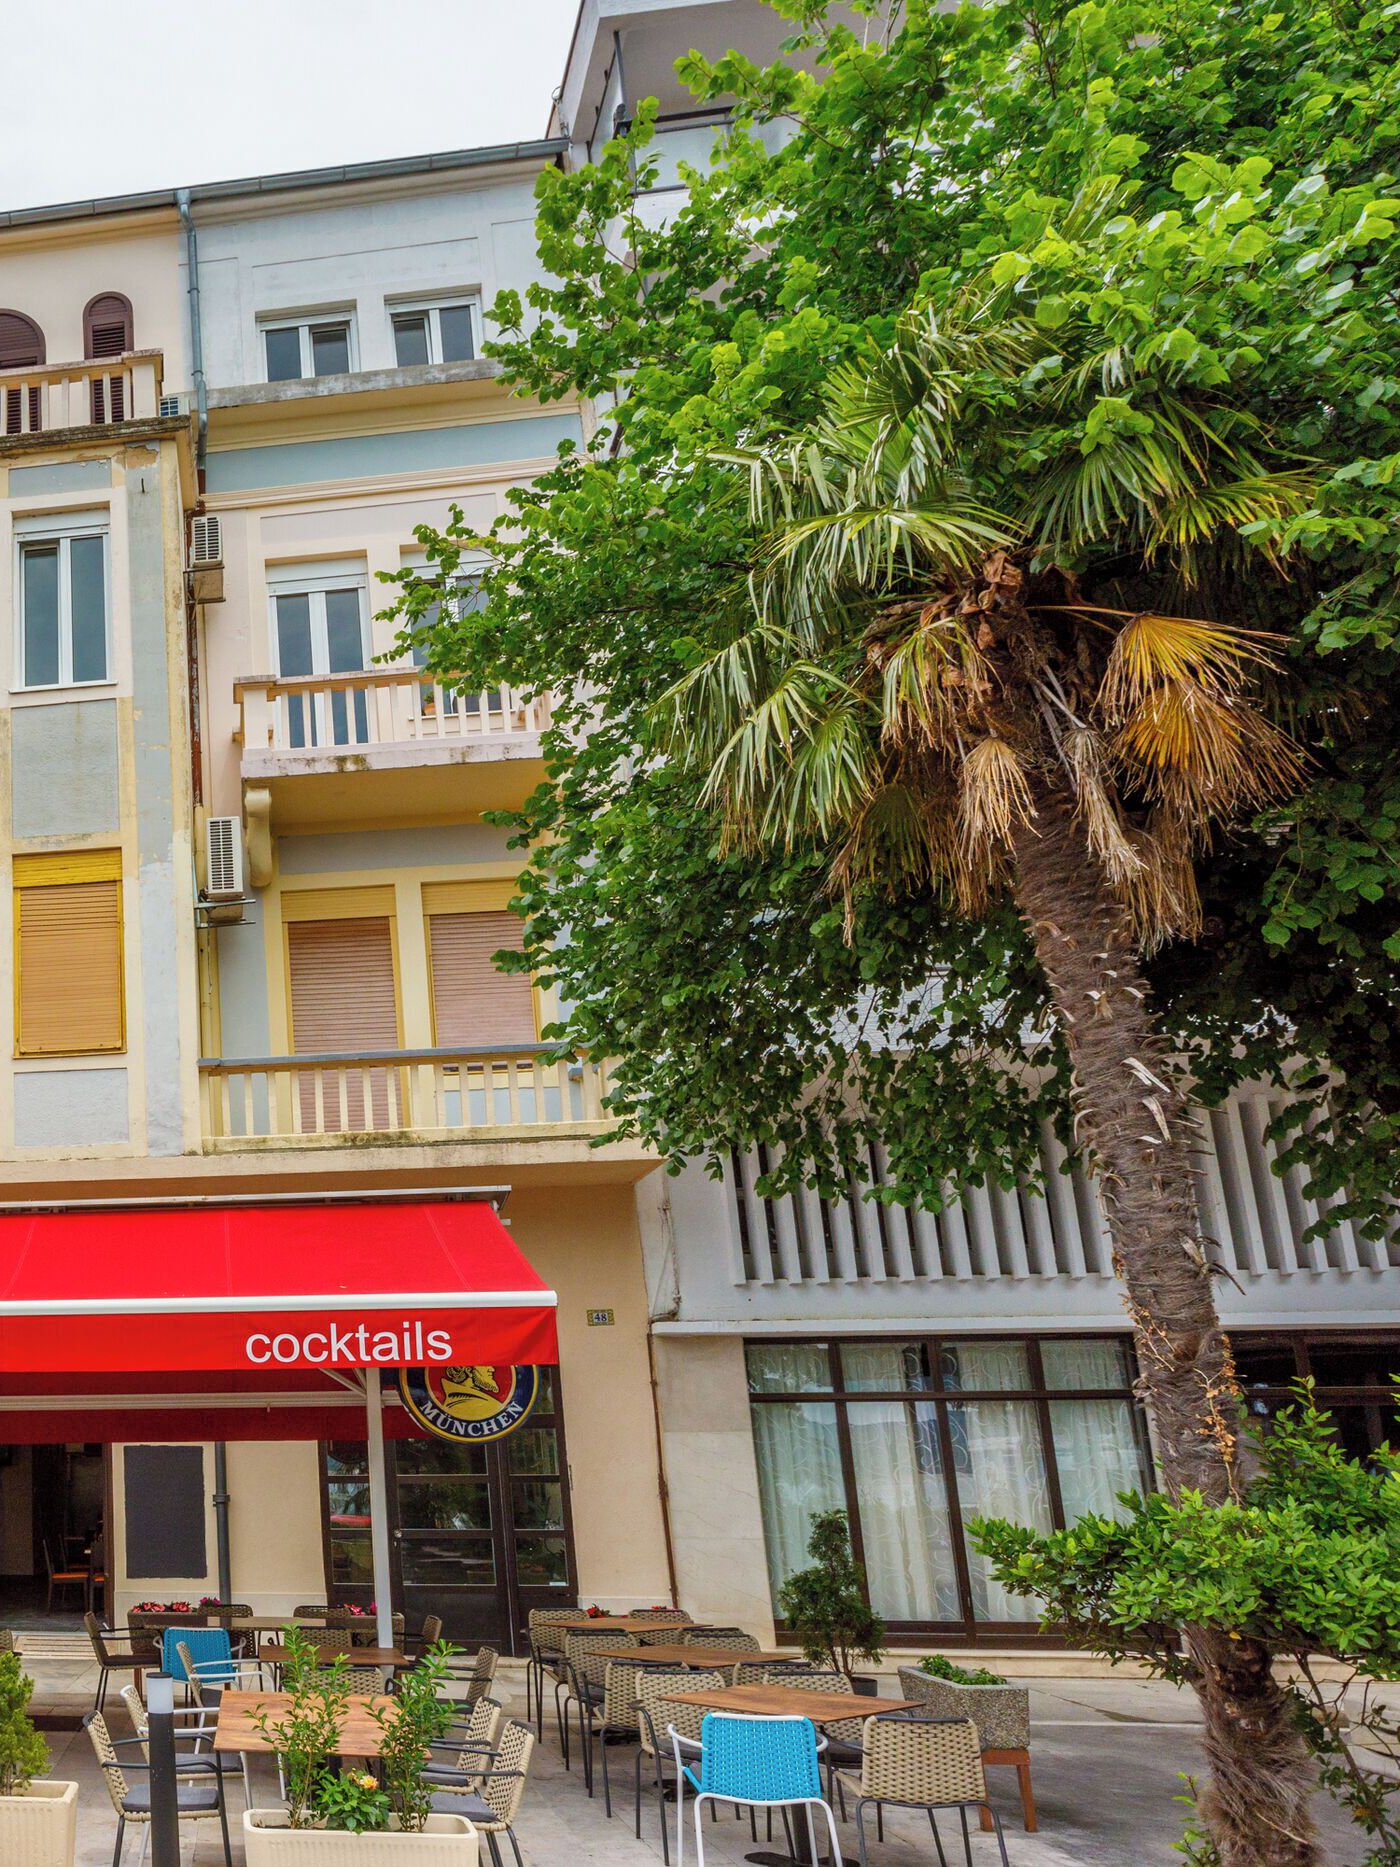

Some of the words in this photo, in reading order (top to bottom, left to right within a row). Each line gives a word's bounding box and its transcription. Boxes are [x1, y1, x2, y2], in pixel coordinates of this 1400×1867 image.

[594, 1313, 608, 1322] 48
[245, 1321, 453, 1363] cocktails
[420, 1401, 524, 1437] MÜNCHEN
